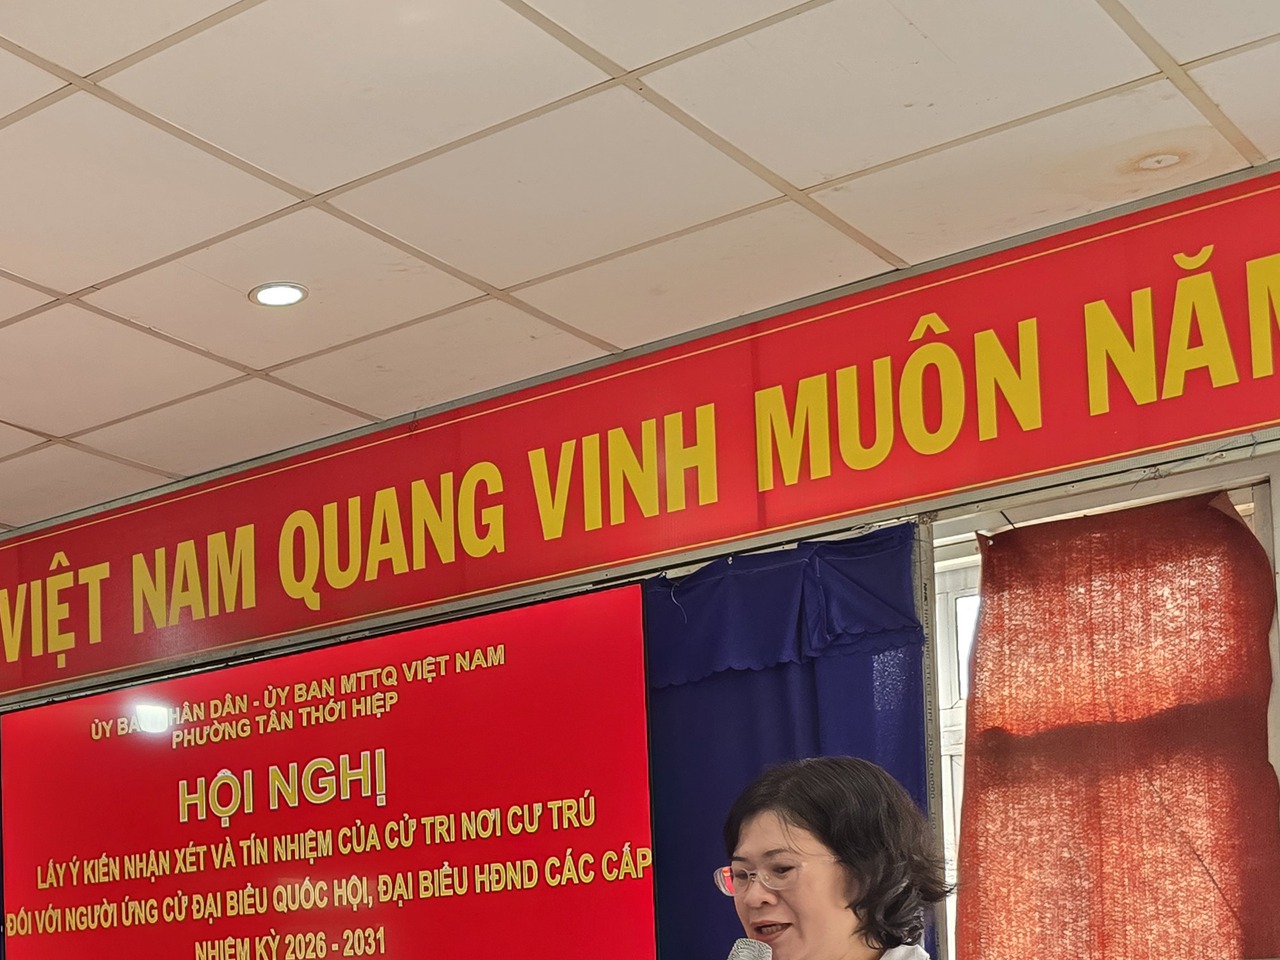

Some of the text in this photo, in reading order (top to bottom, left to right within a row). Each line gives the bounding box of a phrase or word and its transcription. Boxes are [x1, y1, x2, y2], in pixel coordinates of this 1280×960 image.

[131, 523, 256, 634] NAM
[279, 461, 505, 611] QUANG
[528, 402, 718, 540] VINH
[755, 313, 1042, 492] MUÔN
[90, 718, 114, 741] ỦY
[117, 716, 145, 737] BA
[168, 701, 205, 727] HÂN
[210, 693, 248, 719] DÂN
[263, 685, 290, 709] ỦY
[294, 677, 335, 703] BAN
[340, 666, 398, 694] MTTQ
[405, 656, 449, 683] VIỆT
[455, 644, 506, 672] NAM
[171, 691, 399, 749] PHƯỜNG TÂN THỚI HIỆP
[179, 748, 386, 828] HỘI NGHỊ
[36, 789, 595, 890] LẤY Ý KIẾN NHẬN XÉT VÀ TÍN NHIỆM CỦA CỬ TRI NƠI CƯ TRÚ
[6, 841, 652, 937] ĐỐI VỚI NGƯỜI ỨNG CỬ ĐẠI BIỂU QUỐC HỘI, ĐẠI BIỂU HĐND CÁC CẤP
[284, 932, 327, 960] 2026
[331, 942, 339, 951] -
[342, 926, 385, 957] 2031
